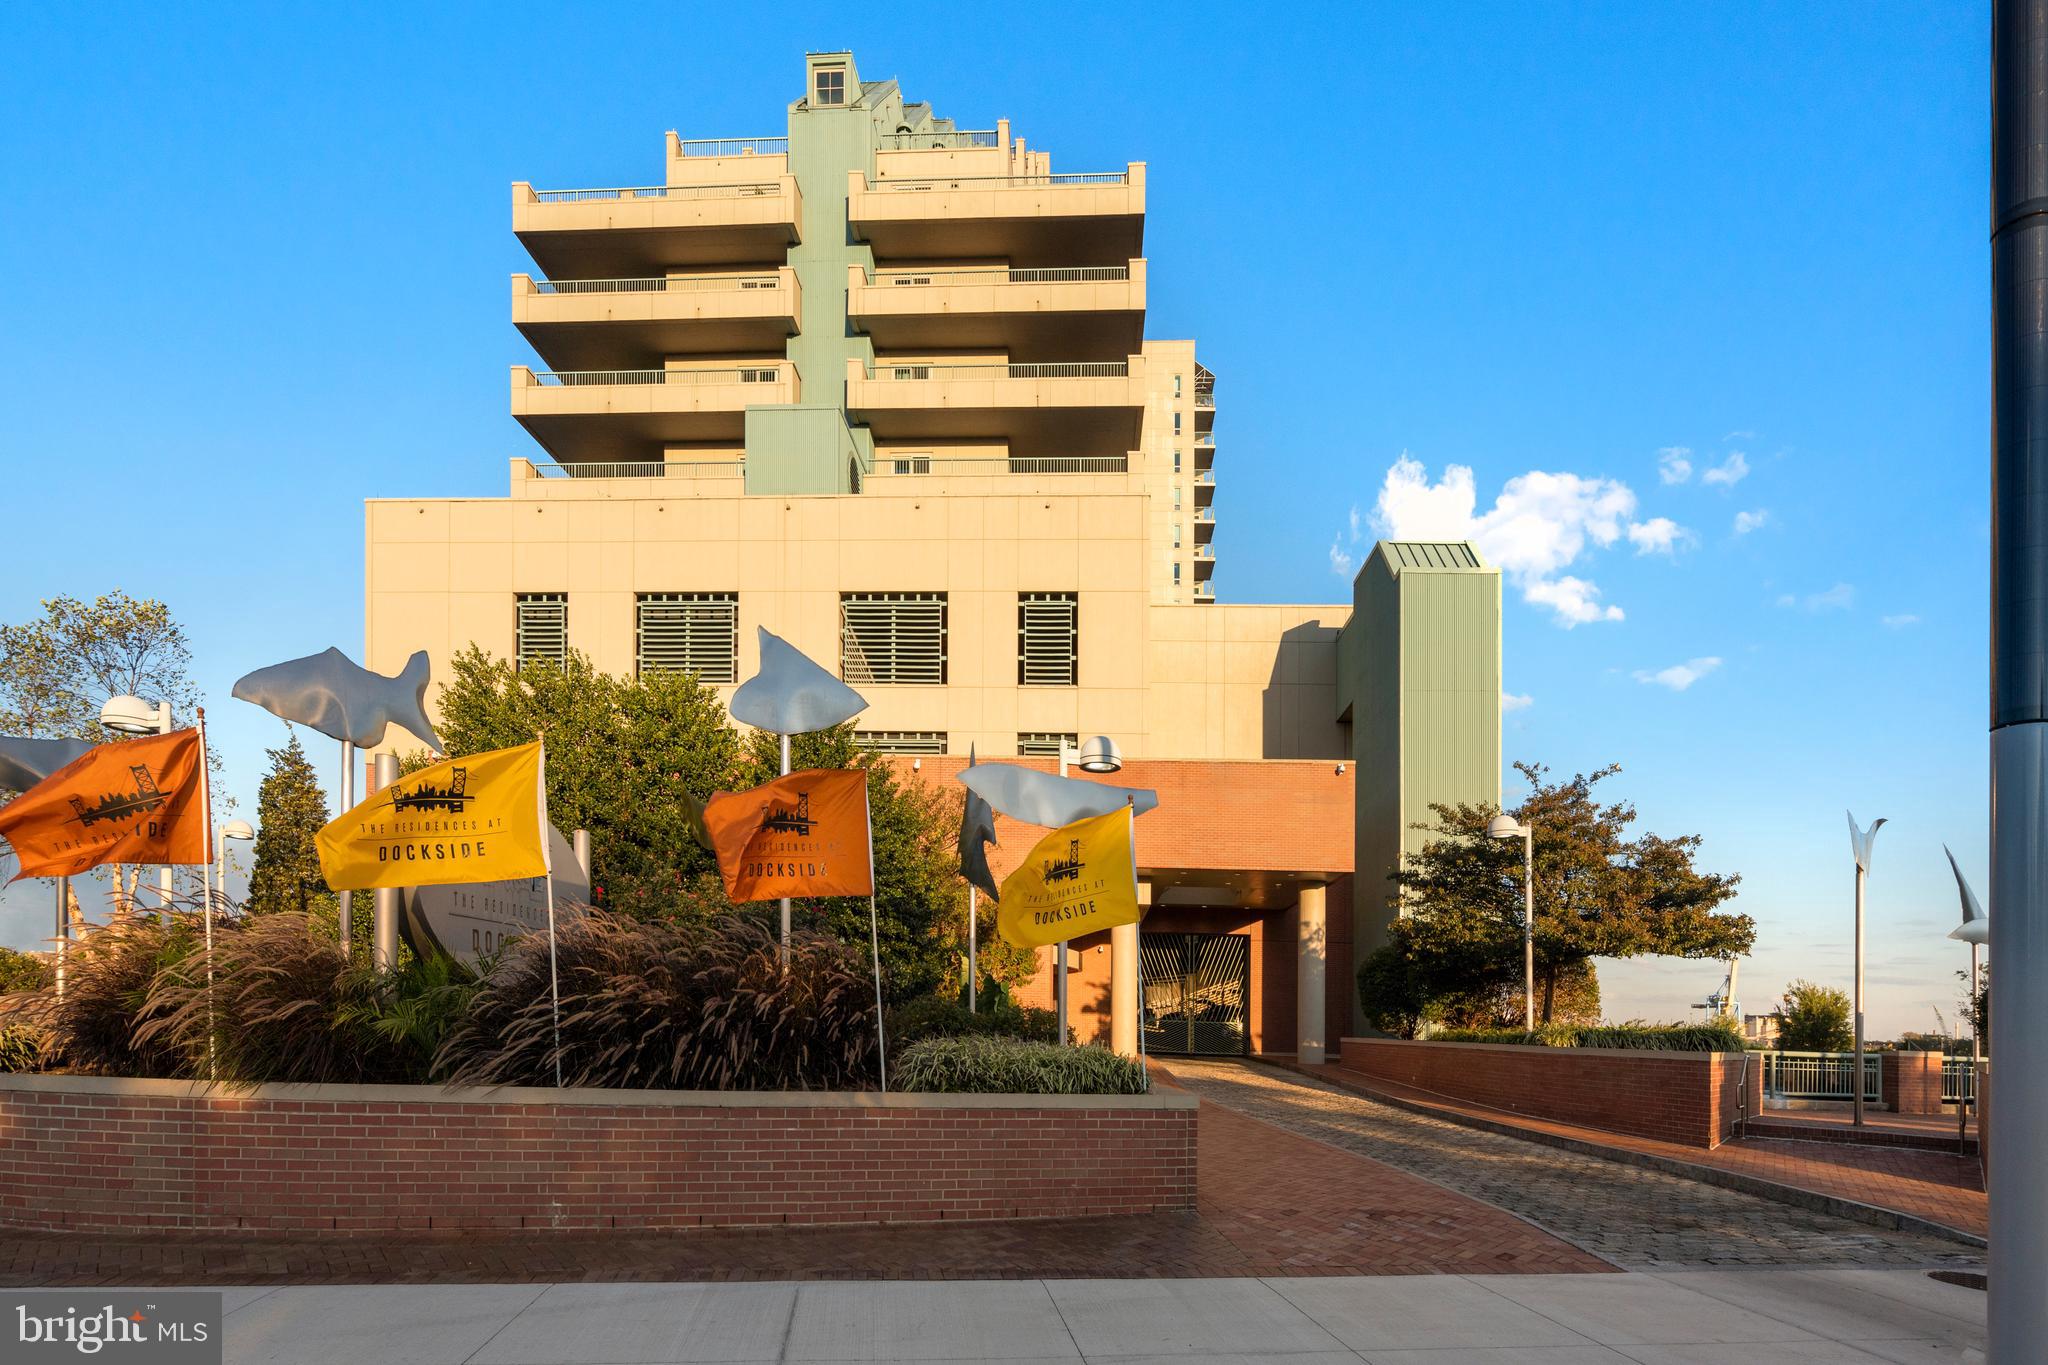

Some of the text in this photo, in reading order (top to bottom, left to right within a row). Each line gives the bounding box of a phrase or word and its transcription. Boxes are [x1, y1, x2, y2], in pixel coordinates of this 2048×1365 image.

[359, 817, 501, 834] THE RESIDENCES AT
[53, 838, 82, 852] THE
[378, 841, 486, 862] DOCKSIDE
[748, 862, 828, 877] DOCKSIDE
[1094, 879, 1105, 890] AT
[452, 890, 475, 910] THE
[1034, 900, 1096, 925] DOCKSIDE
